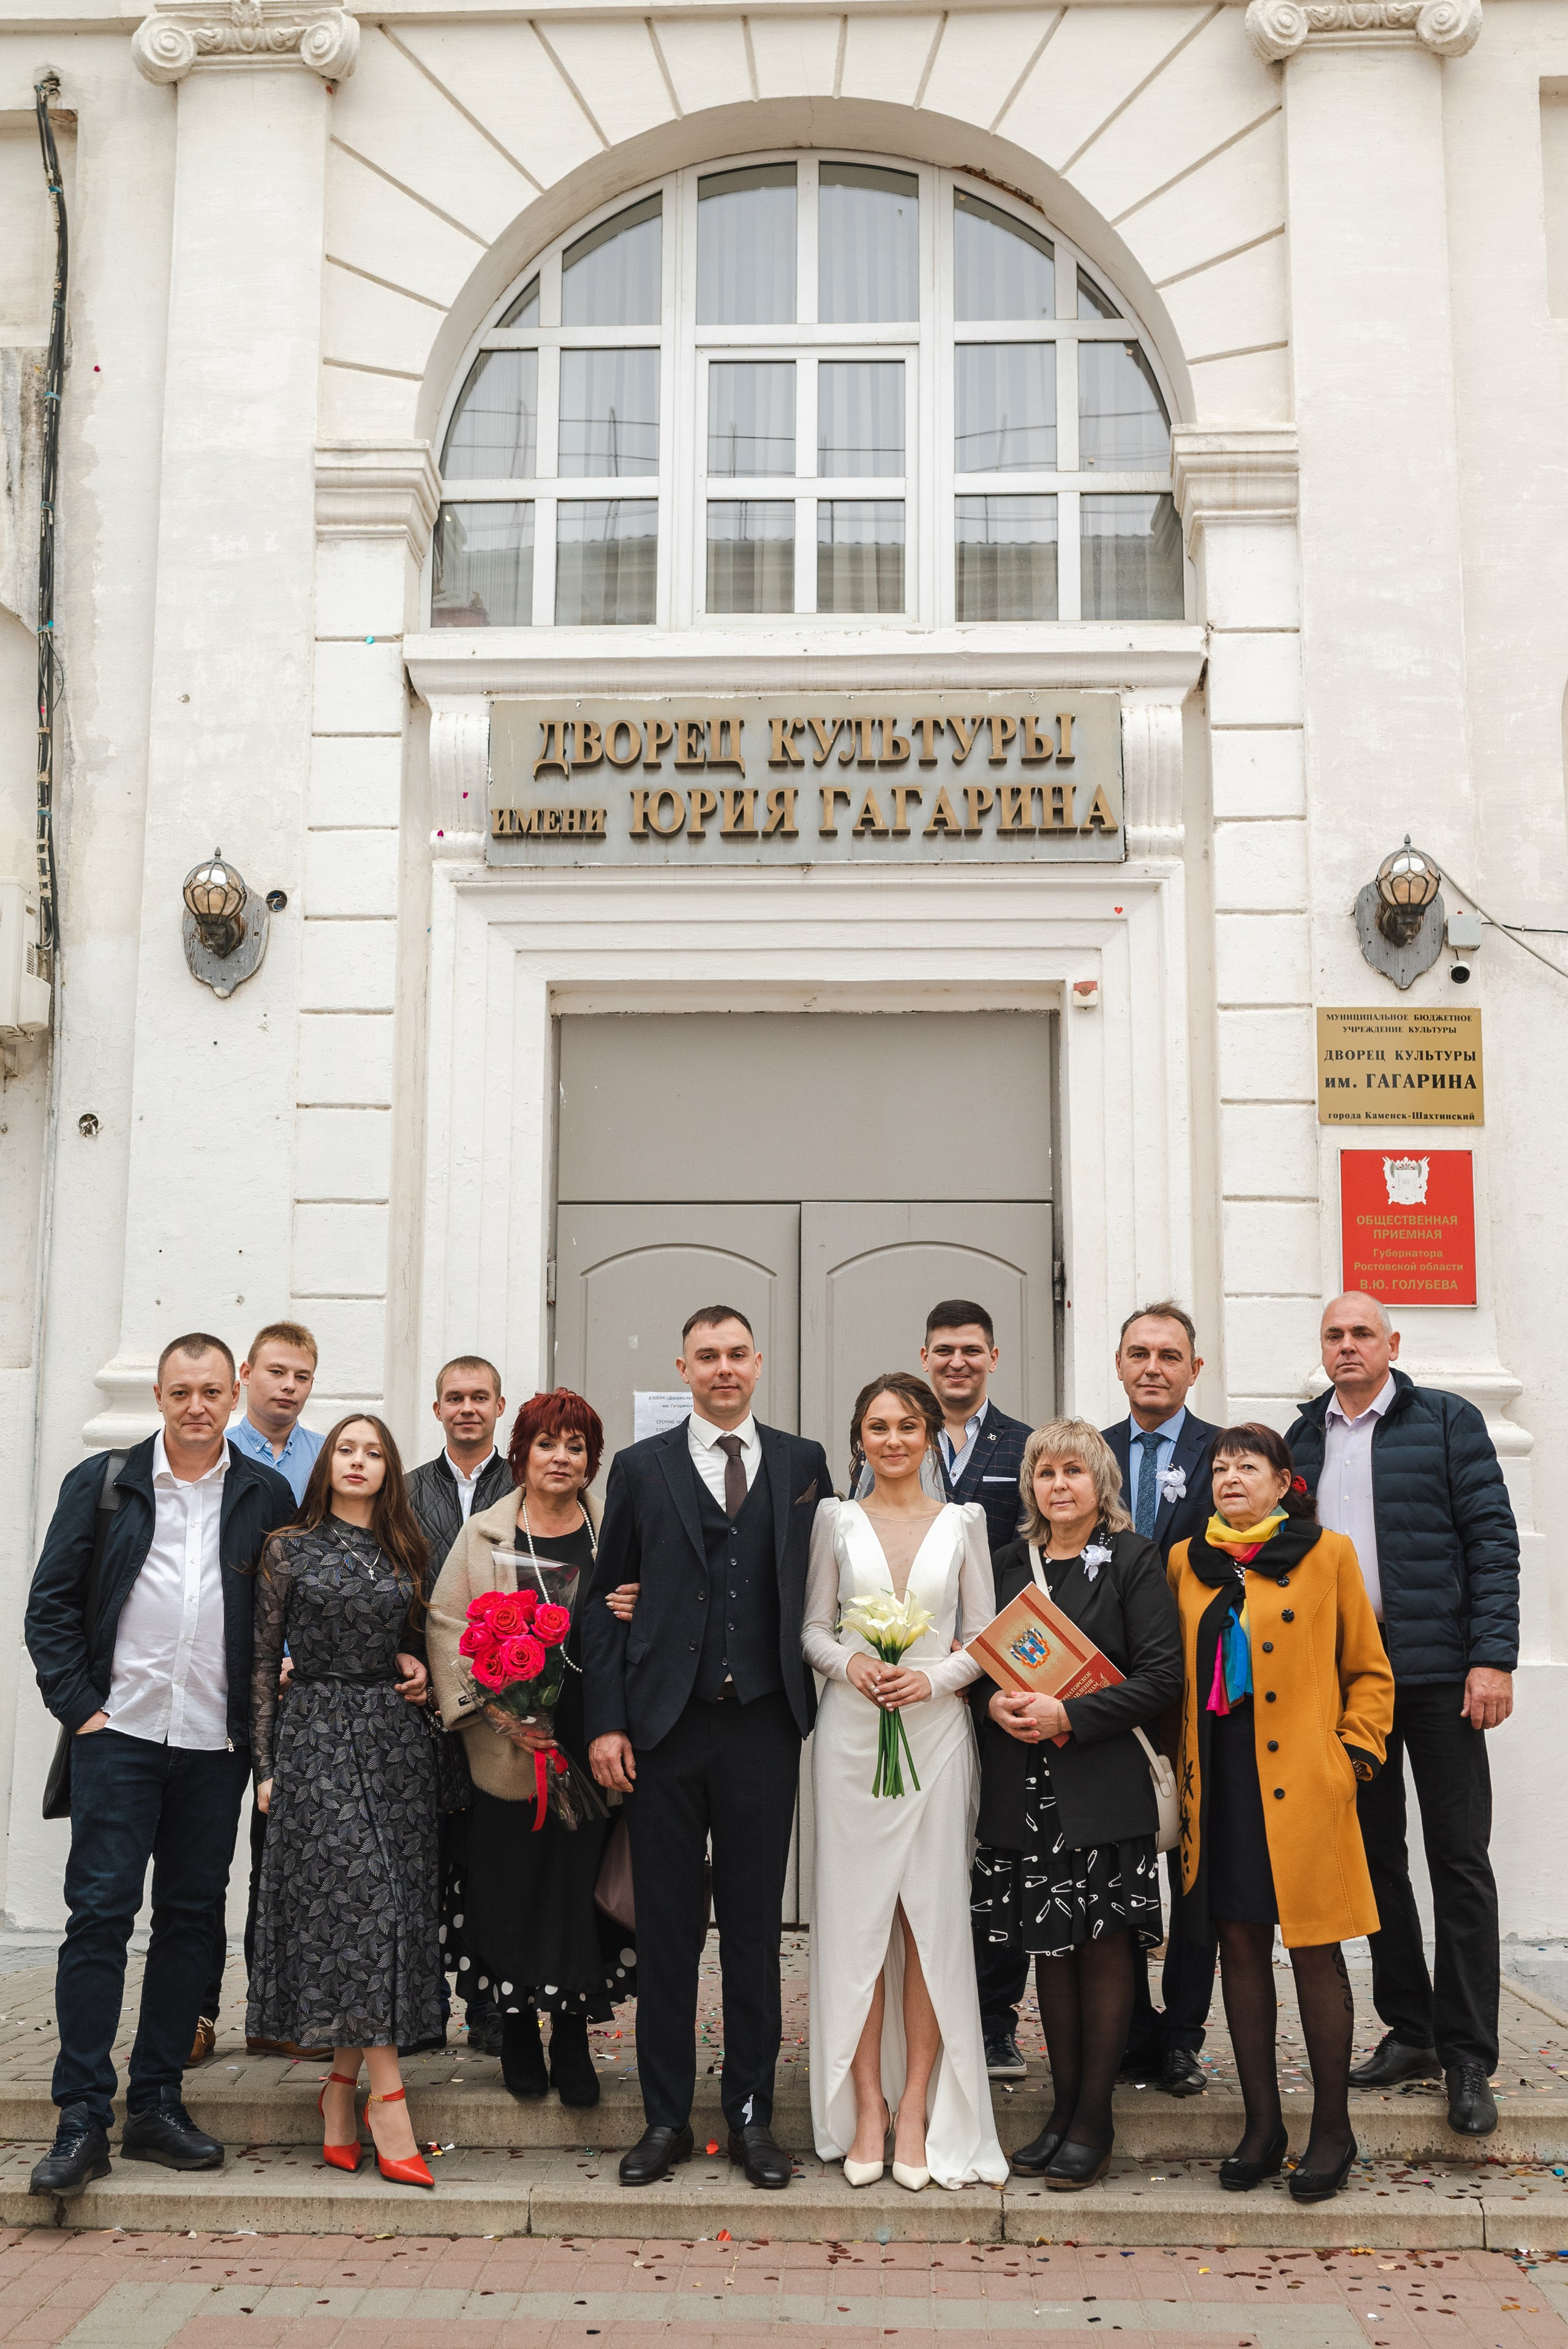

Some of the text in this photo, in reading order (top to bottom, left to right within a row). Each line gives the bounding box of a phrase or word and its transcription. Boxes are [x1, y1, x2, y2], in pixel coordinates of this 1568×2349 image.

[532, 713, 1076, 779] ДВОРЕЦ КУЛЬТУРЫ
[490, 783, 1120, 839] ИМЕНИ ЮРИЯ ГАГАРИНА
[1324, 1050, 1476, 1062] ДВОРЕЦ КУЛЬТУРЫ
[1325, 1073, 1477, 1089] им. ГАГАРИНА
[1328, 1111, 1475, 1121] города Каменск-Шахтинский
[1356, 1215, 1458, 1226] ОБЩЕСТВЕННАЯ
[1373, 1229, 1442, 1239] ПРИЕМНАЯ
[1373, 1249, 1443, 1259] Губернатора
[1354, 1262, 1463, 1271] Ростовской области
[1360, 1279, 1458, 1290] В.Ю. ГОЛУБЕВА
